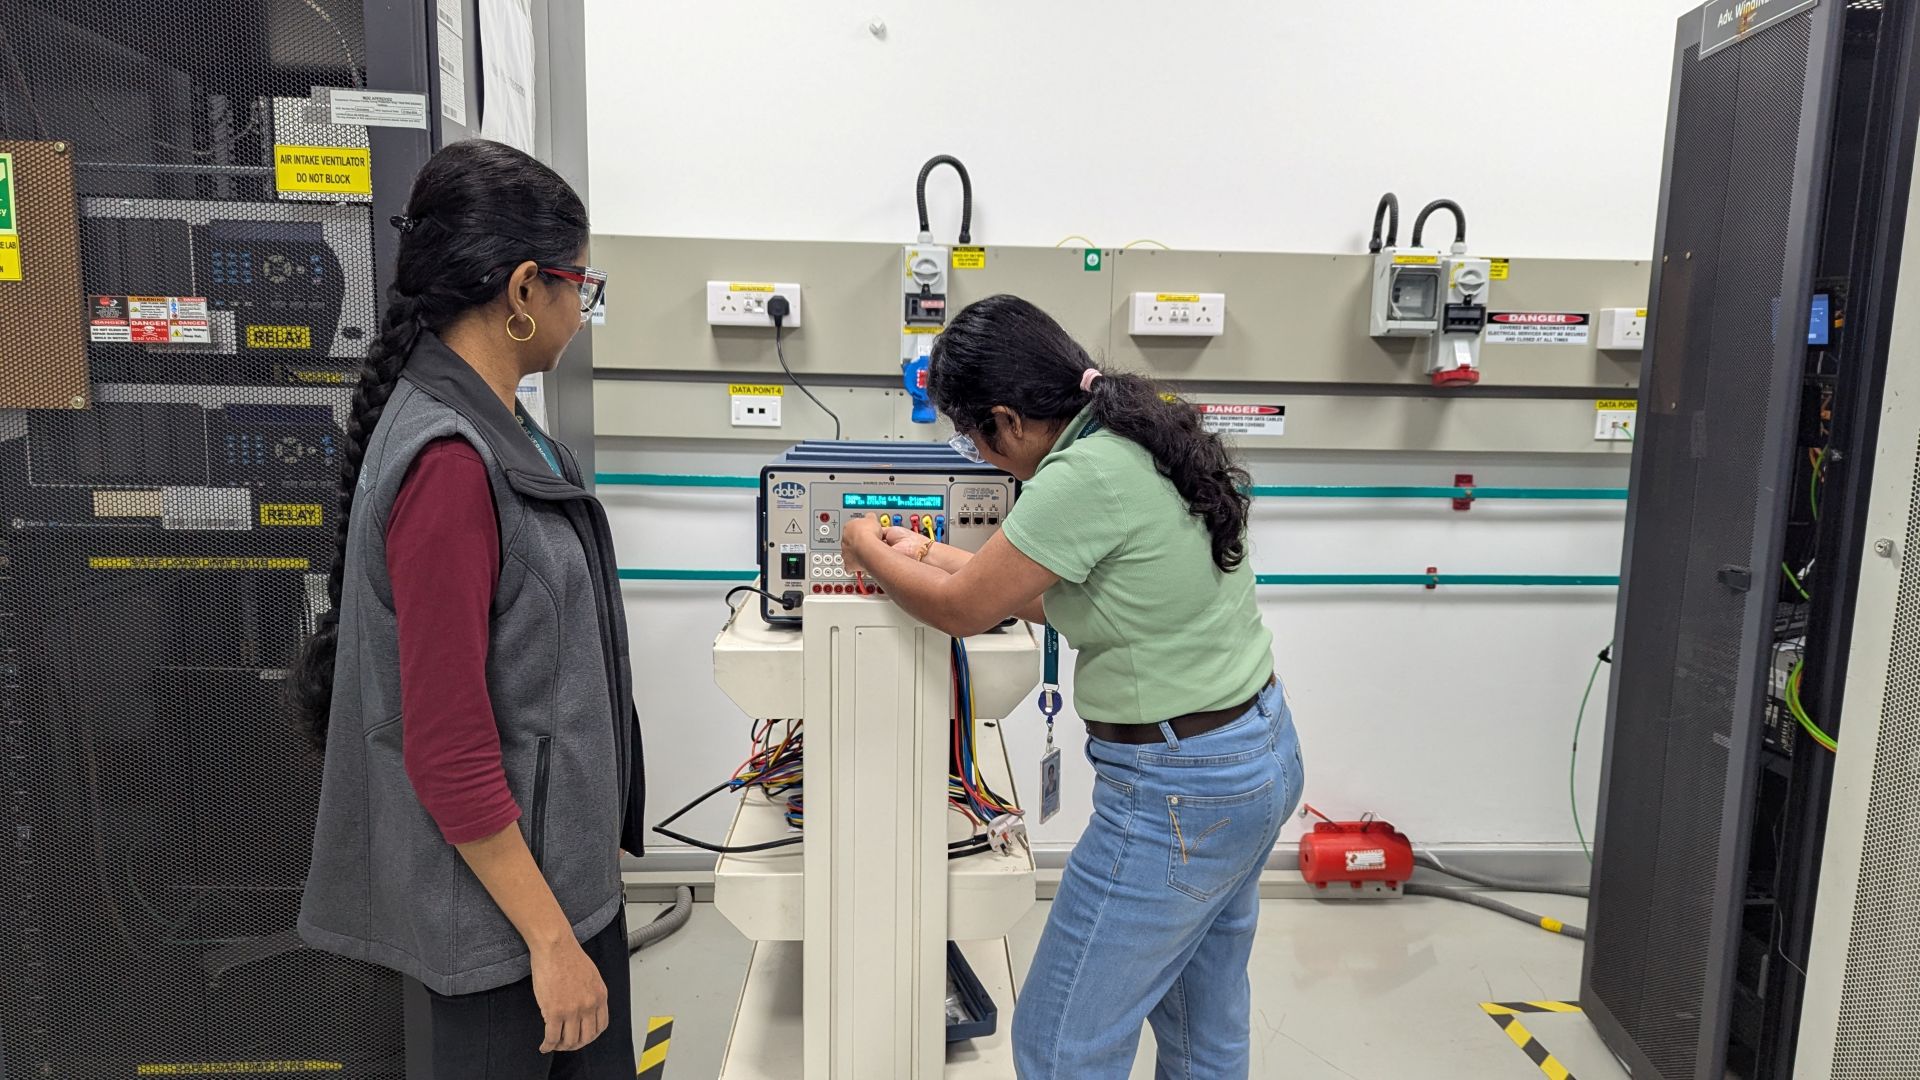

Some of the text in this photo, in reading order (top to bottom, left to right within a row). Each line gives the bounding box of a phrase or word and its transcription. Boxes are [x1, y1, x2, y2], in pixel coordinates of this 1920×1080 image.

[1717, 9, 1733, 28] Adv.
[280, 154, 366, 167] AIR INTAKE VENTILATOR
[296, 173, 351, 184] DO NOT BLOCK
[1509, 314, 1566, 322] DANGER
[255, 331, 302, 342] RELAY
[1598, 401, 1617, 409] DATA
[774, 484, 805, 498] doble
[267, 509, 315, 521] RELAY
